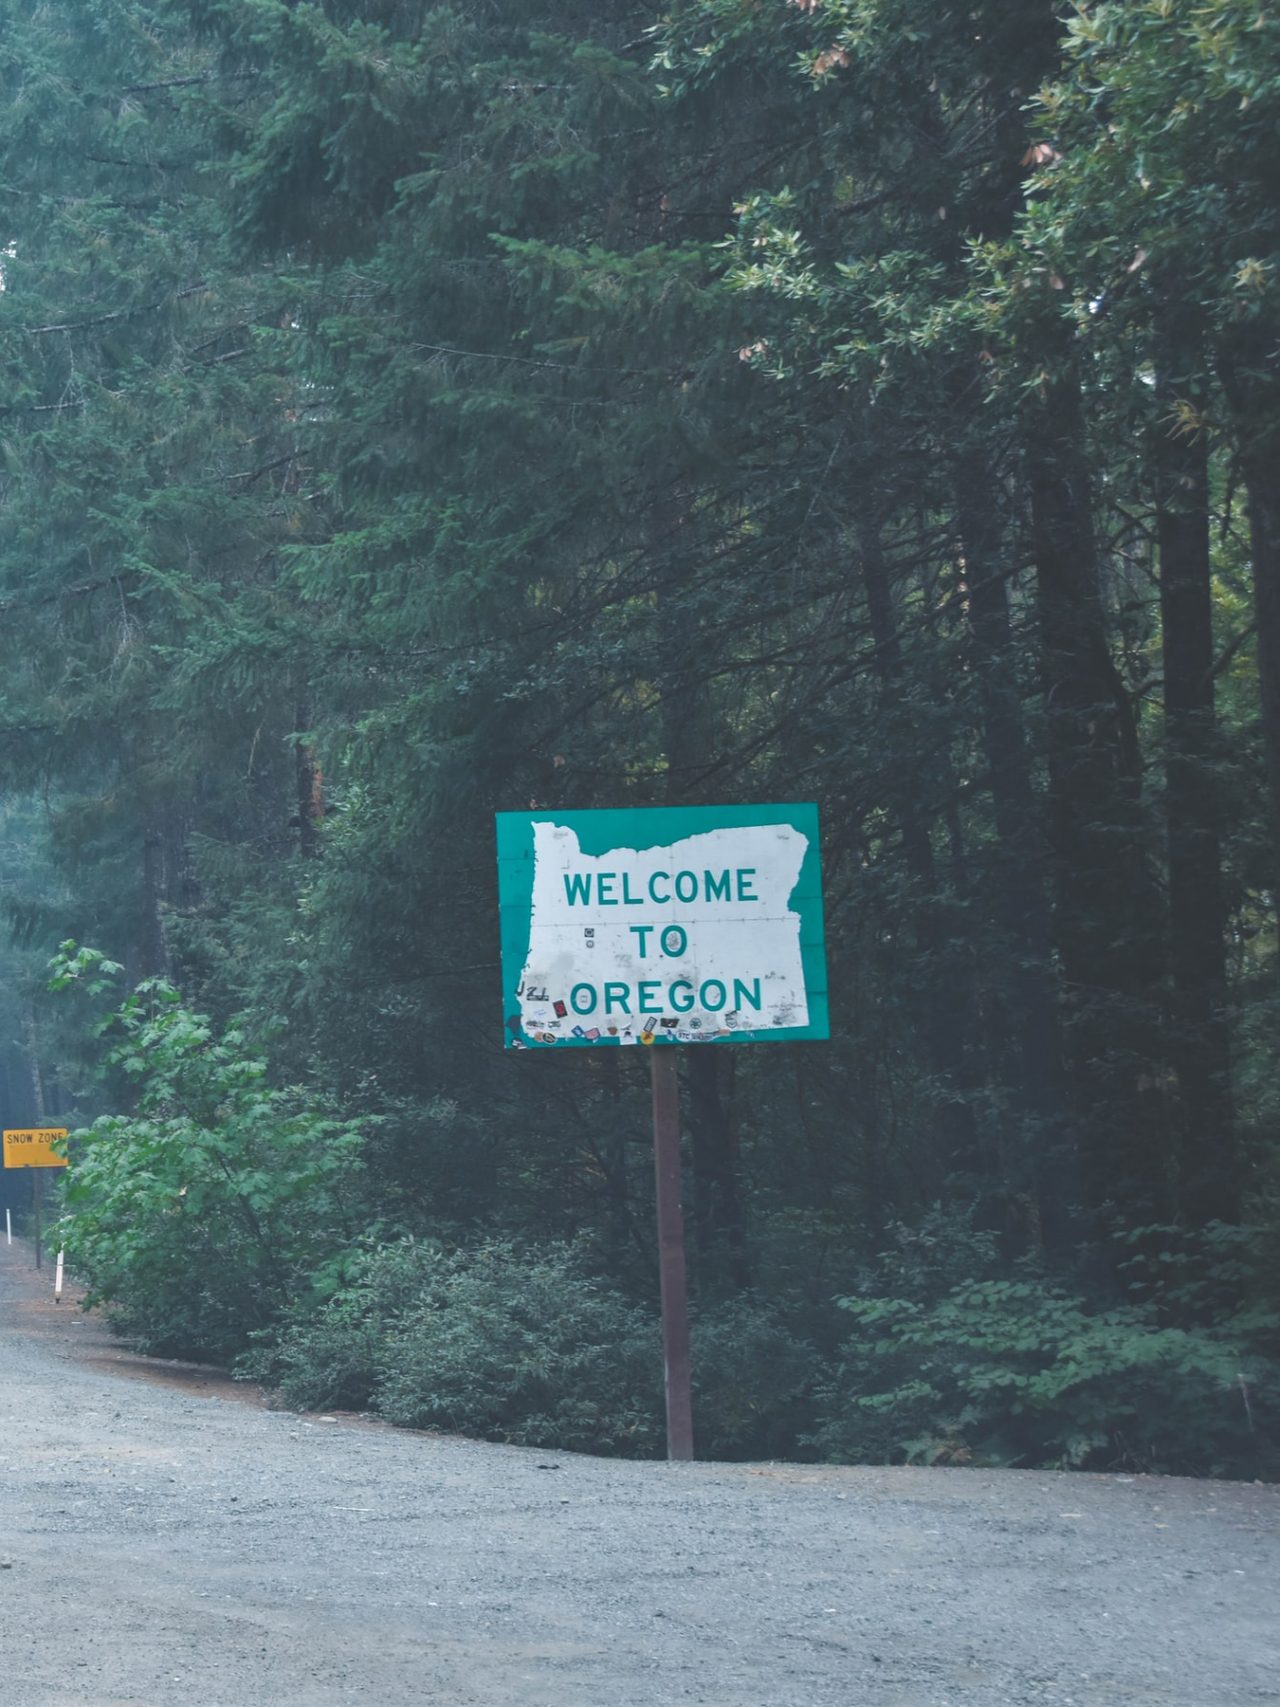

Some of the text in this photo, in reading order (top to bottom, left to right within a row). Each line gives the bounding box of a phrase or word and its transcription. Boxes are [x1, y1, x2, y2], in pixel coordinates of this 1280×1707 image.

[563, 868, 758, 906] WELCOME
[629, 924, 688, 958] TO
[570, 978, 761, 1015] OREGON
[7, 1133, 33, 1145] SNOW
